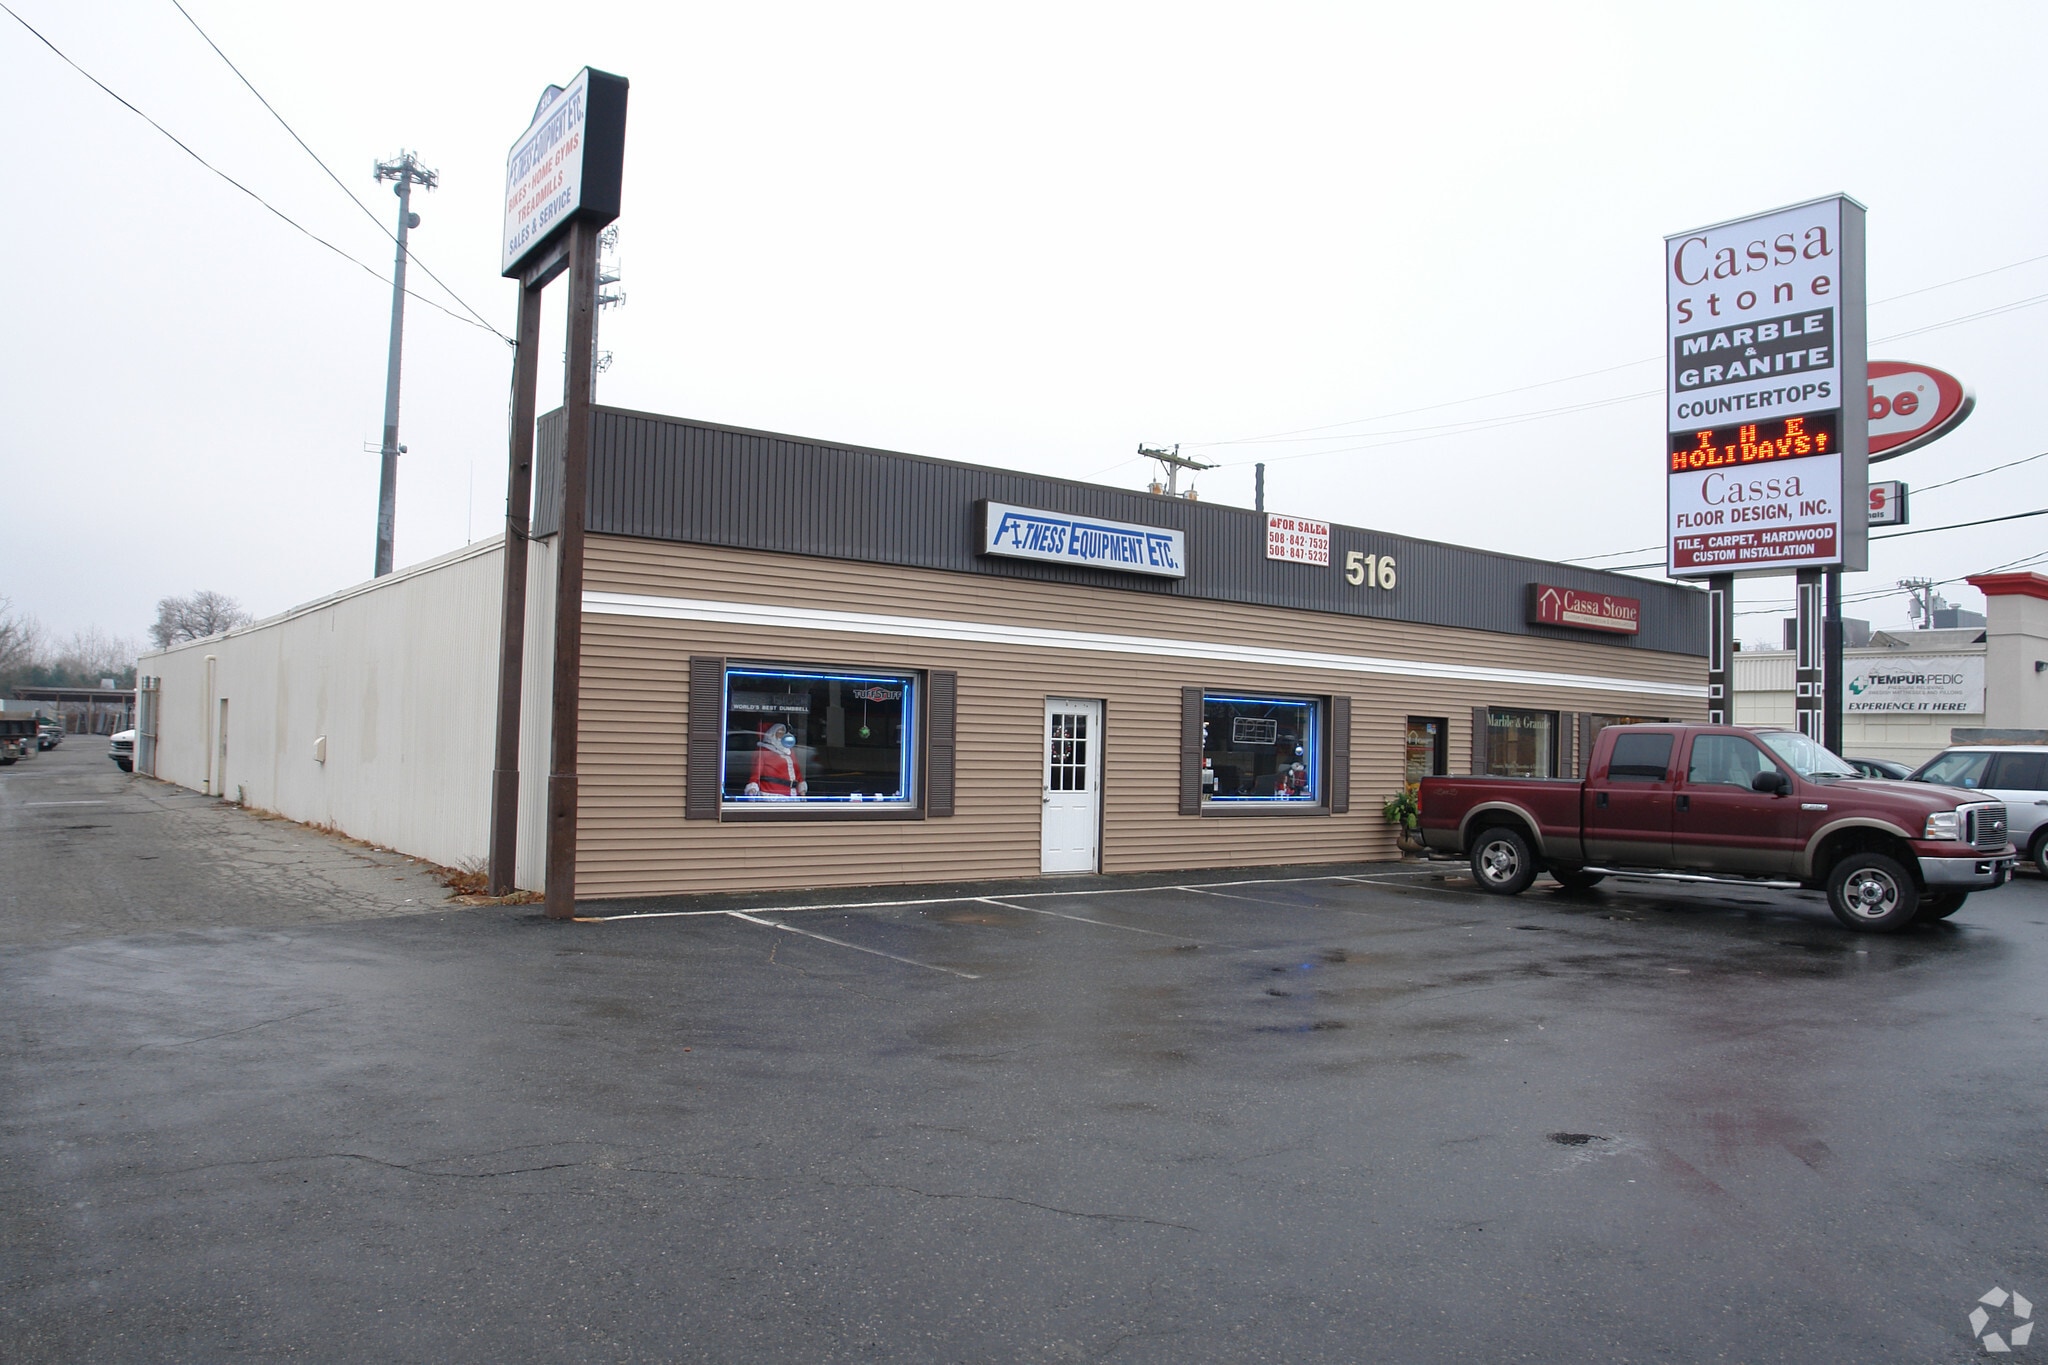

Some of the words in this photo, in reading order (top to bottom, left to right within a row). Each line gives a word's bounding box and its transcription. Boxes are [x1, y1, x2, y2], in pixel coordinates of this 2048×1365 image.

[567, 84, 584, 131] ETC.
[508, 183, 527, 213] BIKES
[531, 156, 553, 190] HOME
[555, 132, 579, 166] GYMS
[518, 169, 563, 224] TREADMILLS
[509, 223, 530, 255] SALES
[532, 217, 537, 235] &
[539, 186, 571, 228] SERVICE
[1673, 225, 1834, 286] Cassa
[1682, 314, 1824, 356] MARBLE
[1744, 347, 1757, 356] &
[1679, 346, 1829, 387] GRANITE
[1677, 381, 1831, 419] COUNTERTOPS
[1701, 473, 1804, 506] Cassa
[1276, 518, 1295, 531] FOR
[1297, 521, 1322, 534] SALE
[1677, 510, 1724, 528] FLOOR
[1731, 503, 1793, 523] DESIGN,
[1800, 499, 1832, 516] INC.
[1068, 522, 1144, 564] EQUIPMENT
[1146, 532, 1179, 569] ETC.
[1677, 538, 1705, 550] TILE,
[1708, 533, 1758, 548] CARPET,
[1762, 527, 1834, 544] HARDWOOD
[1692, 550, 1736, 562] CUSTOM
[1739, 543, 1815, 560] INSTALLATION
[1345, 550, 1397, 590] 516
[1564, 590, 1599, 615] Cassa
[1603, 596, 1636, 620] Stone
[1487, 713, 1513, 728] Marble
[1515, 716, 1521, 728] &
[1848, 702, 1916, 711] EXPERIENCE
[1918, 702, 1930, 711] IT
[1932, 702, 1967, 712] HERE!
